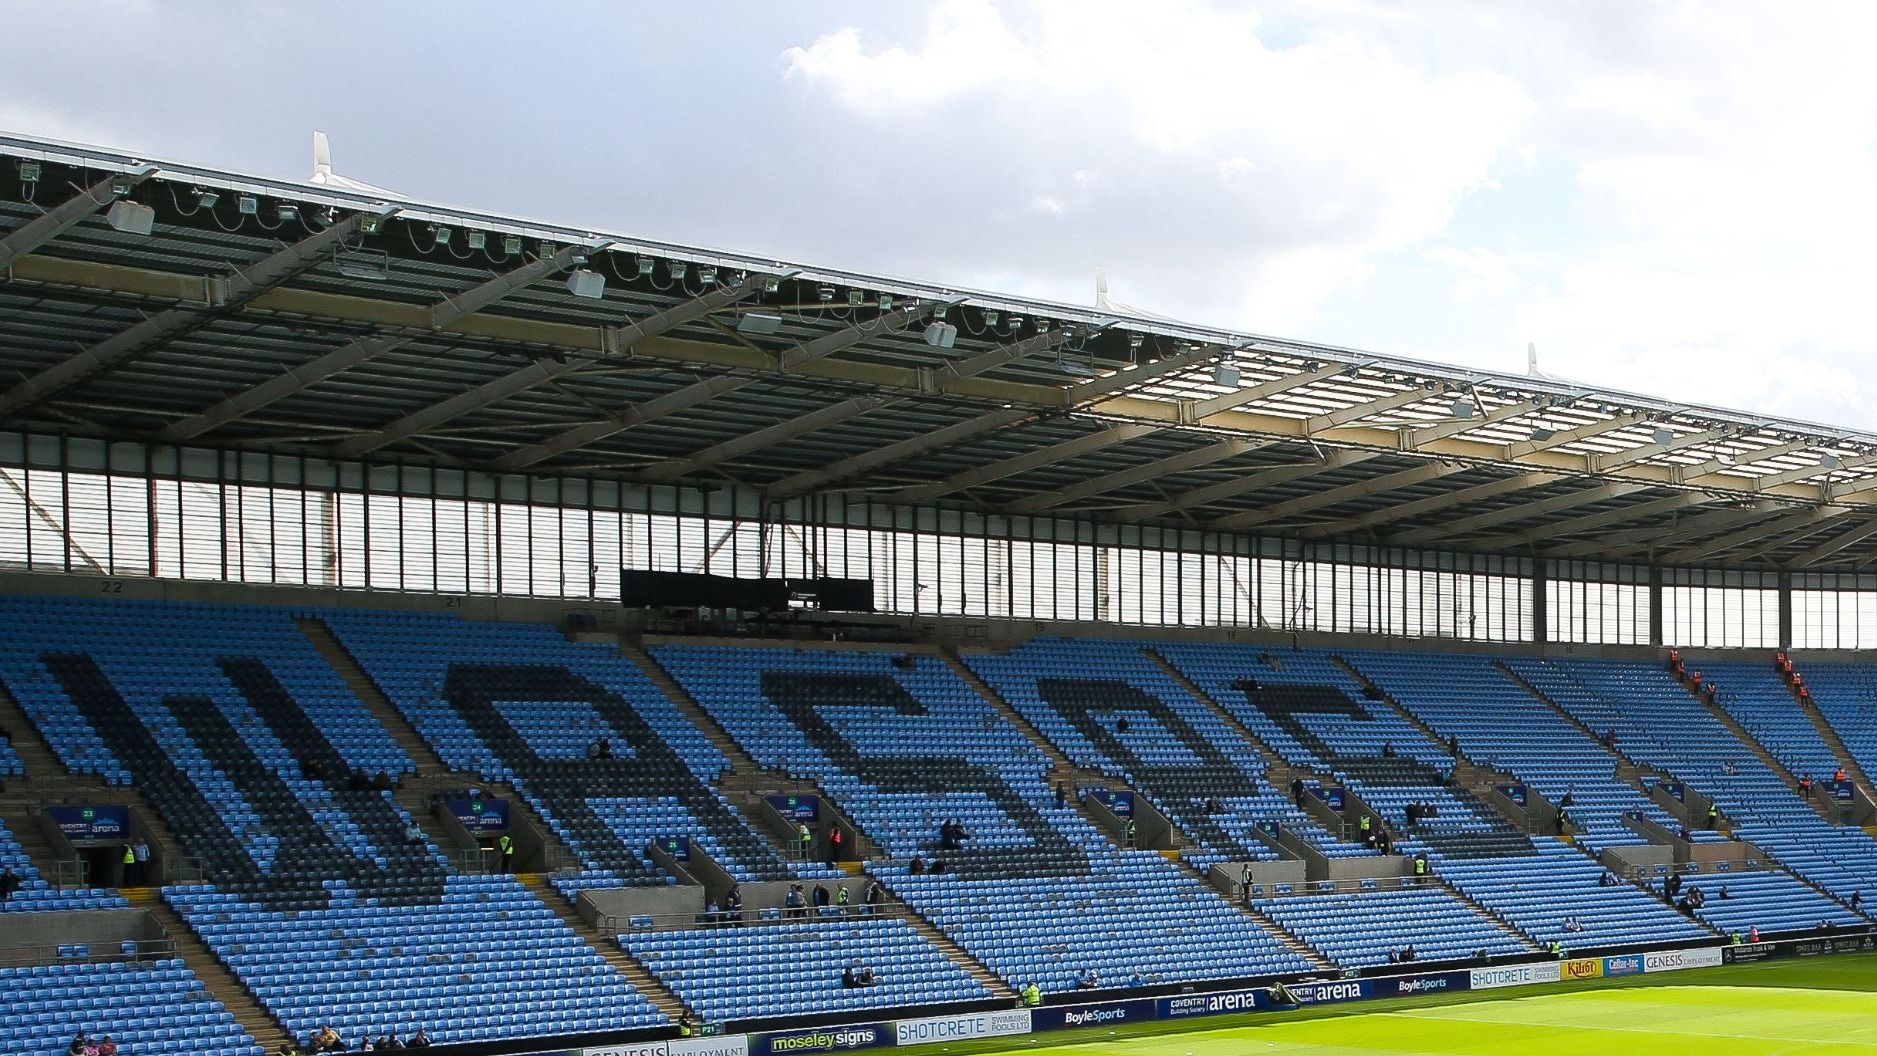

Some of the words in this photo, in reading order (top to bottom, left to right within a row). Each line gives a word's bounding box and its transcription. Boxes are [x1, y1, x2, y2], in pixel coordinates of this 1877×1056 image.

[102, 581, 123, 593] 22
[446, 597, 462, 607] 21
[83, 810, 93, 818] 23
[1646, 954, 1683, 969] GENESIS
[1398, 977, 1447, 992] BoyleSports
[1472, 967, 1531, 987] SHOTCRETE
[1317, 983, 1361, 1001] arena
[1171, 998, 1205, 1008] COVENTRY
[1209, 992, 1255, 1011] arena
[1065, 1008, 1126, 1024] BoyleSports
[1170, 1007, 1189, 1016] Building
[1189, 1005, 1205, 1014] Society
[702, 1026, 715, 1034] P21
[899, 1017, 986, 1041] SHOTCRETE
[991, 1013, 1029, 1024] SWIMMING
[991, 1022, 1016, 1032] POOLS
[1016, 1021, 1029, 1030] LTD
